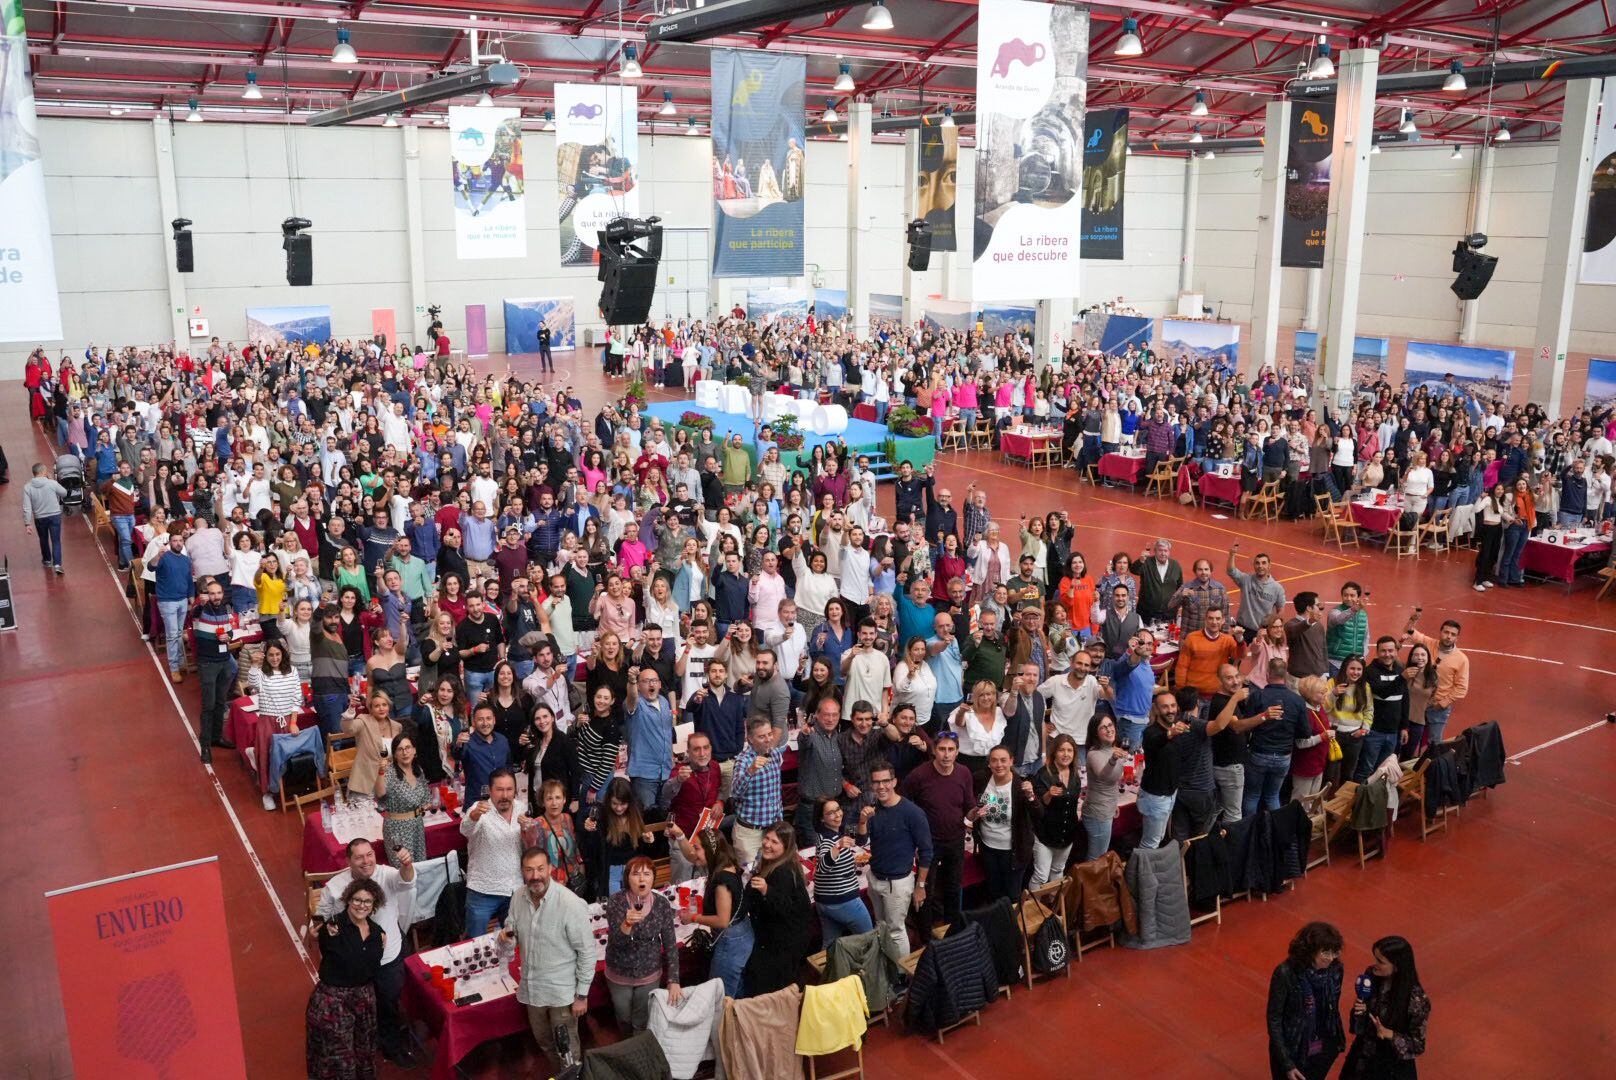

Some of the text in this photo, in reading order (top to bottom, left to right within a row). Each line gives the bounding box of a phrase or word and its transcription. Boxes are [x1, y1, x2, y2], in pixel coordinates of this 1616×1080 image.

[751, 226, 795, 237] La ribera
[1311, 229, 1320, 237] La
[729, 239, 794, 251] que participa
[1020, 233, 1068, 247] La ribera
[993, 249, 1068, 263] que descubre
[96, 896, 184, 940] ENVERO
